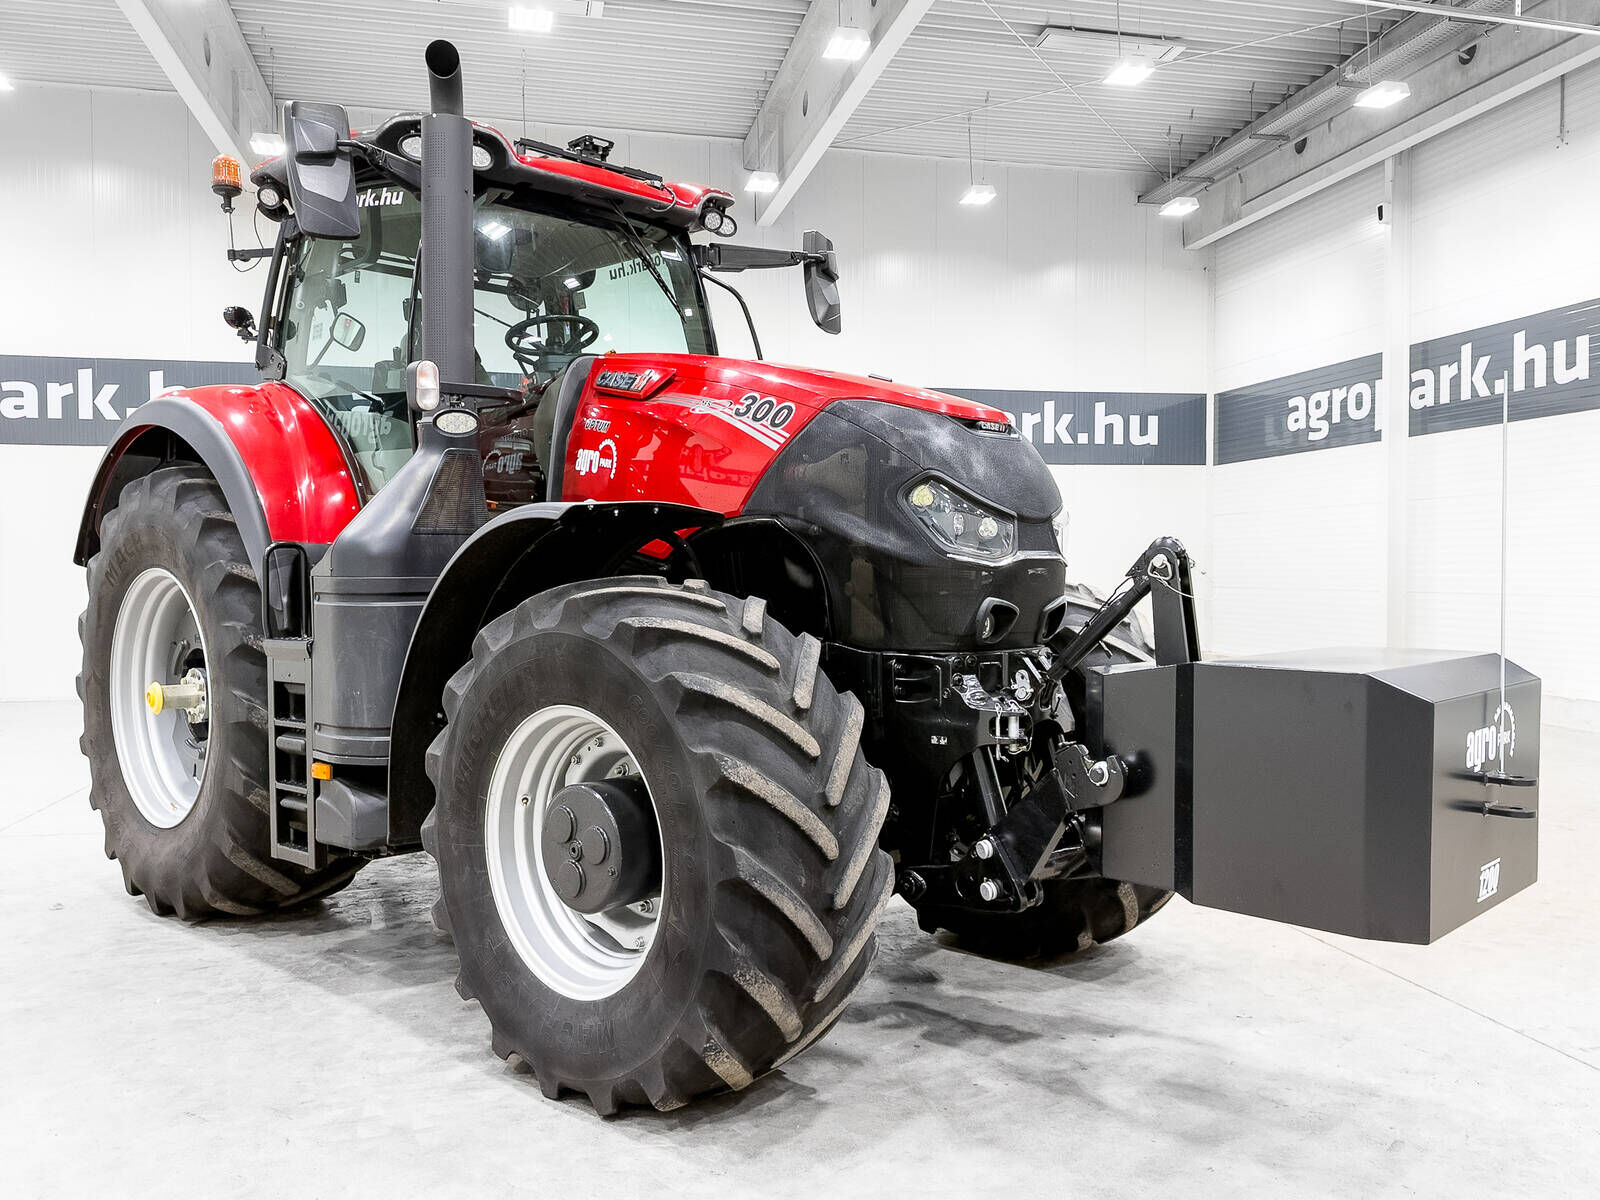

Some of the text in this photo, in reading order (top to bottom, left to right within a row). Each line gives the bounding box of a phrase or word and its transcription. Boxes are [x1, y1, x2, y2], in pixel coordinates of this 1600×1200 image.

[734, 392, 795, 429] 300
[575, 448, 600, 476] agro
[1465, 724, 1497, 773] agro
[1479, 862, 1501, 899] 1200
